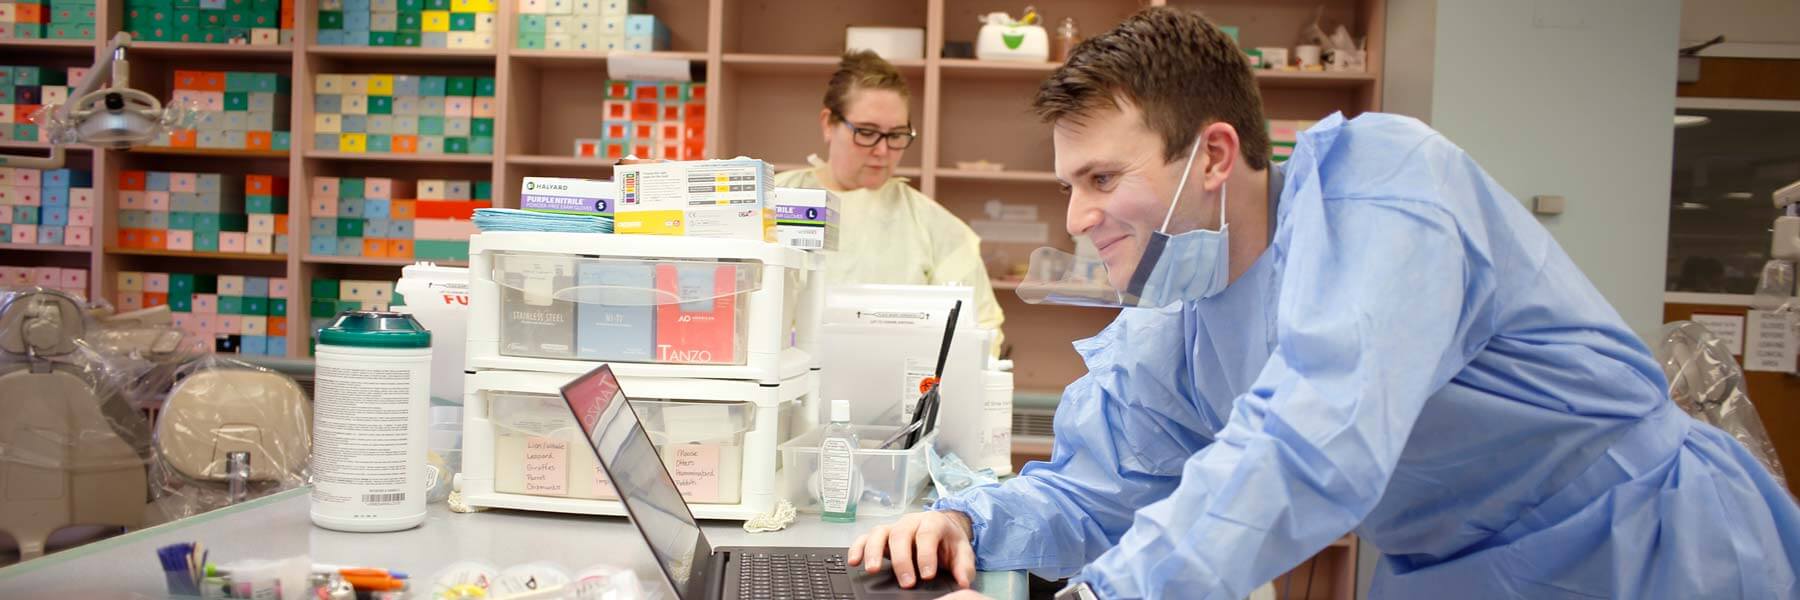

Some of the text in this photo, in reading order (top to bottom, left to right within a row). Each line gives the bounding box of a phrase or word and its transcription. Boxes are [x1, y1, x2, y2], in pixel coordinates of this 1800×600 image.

[527, 196, 583, 206] PURPLE NITRILE
[513, 311, 565, 322] STAINLESS STEEL
[657, 344, 712, 363] TANZO
